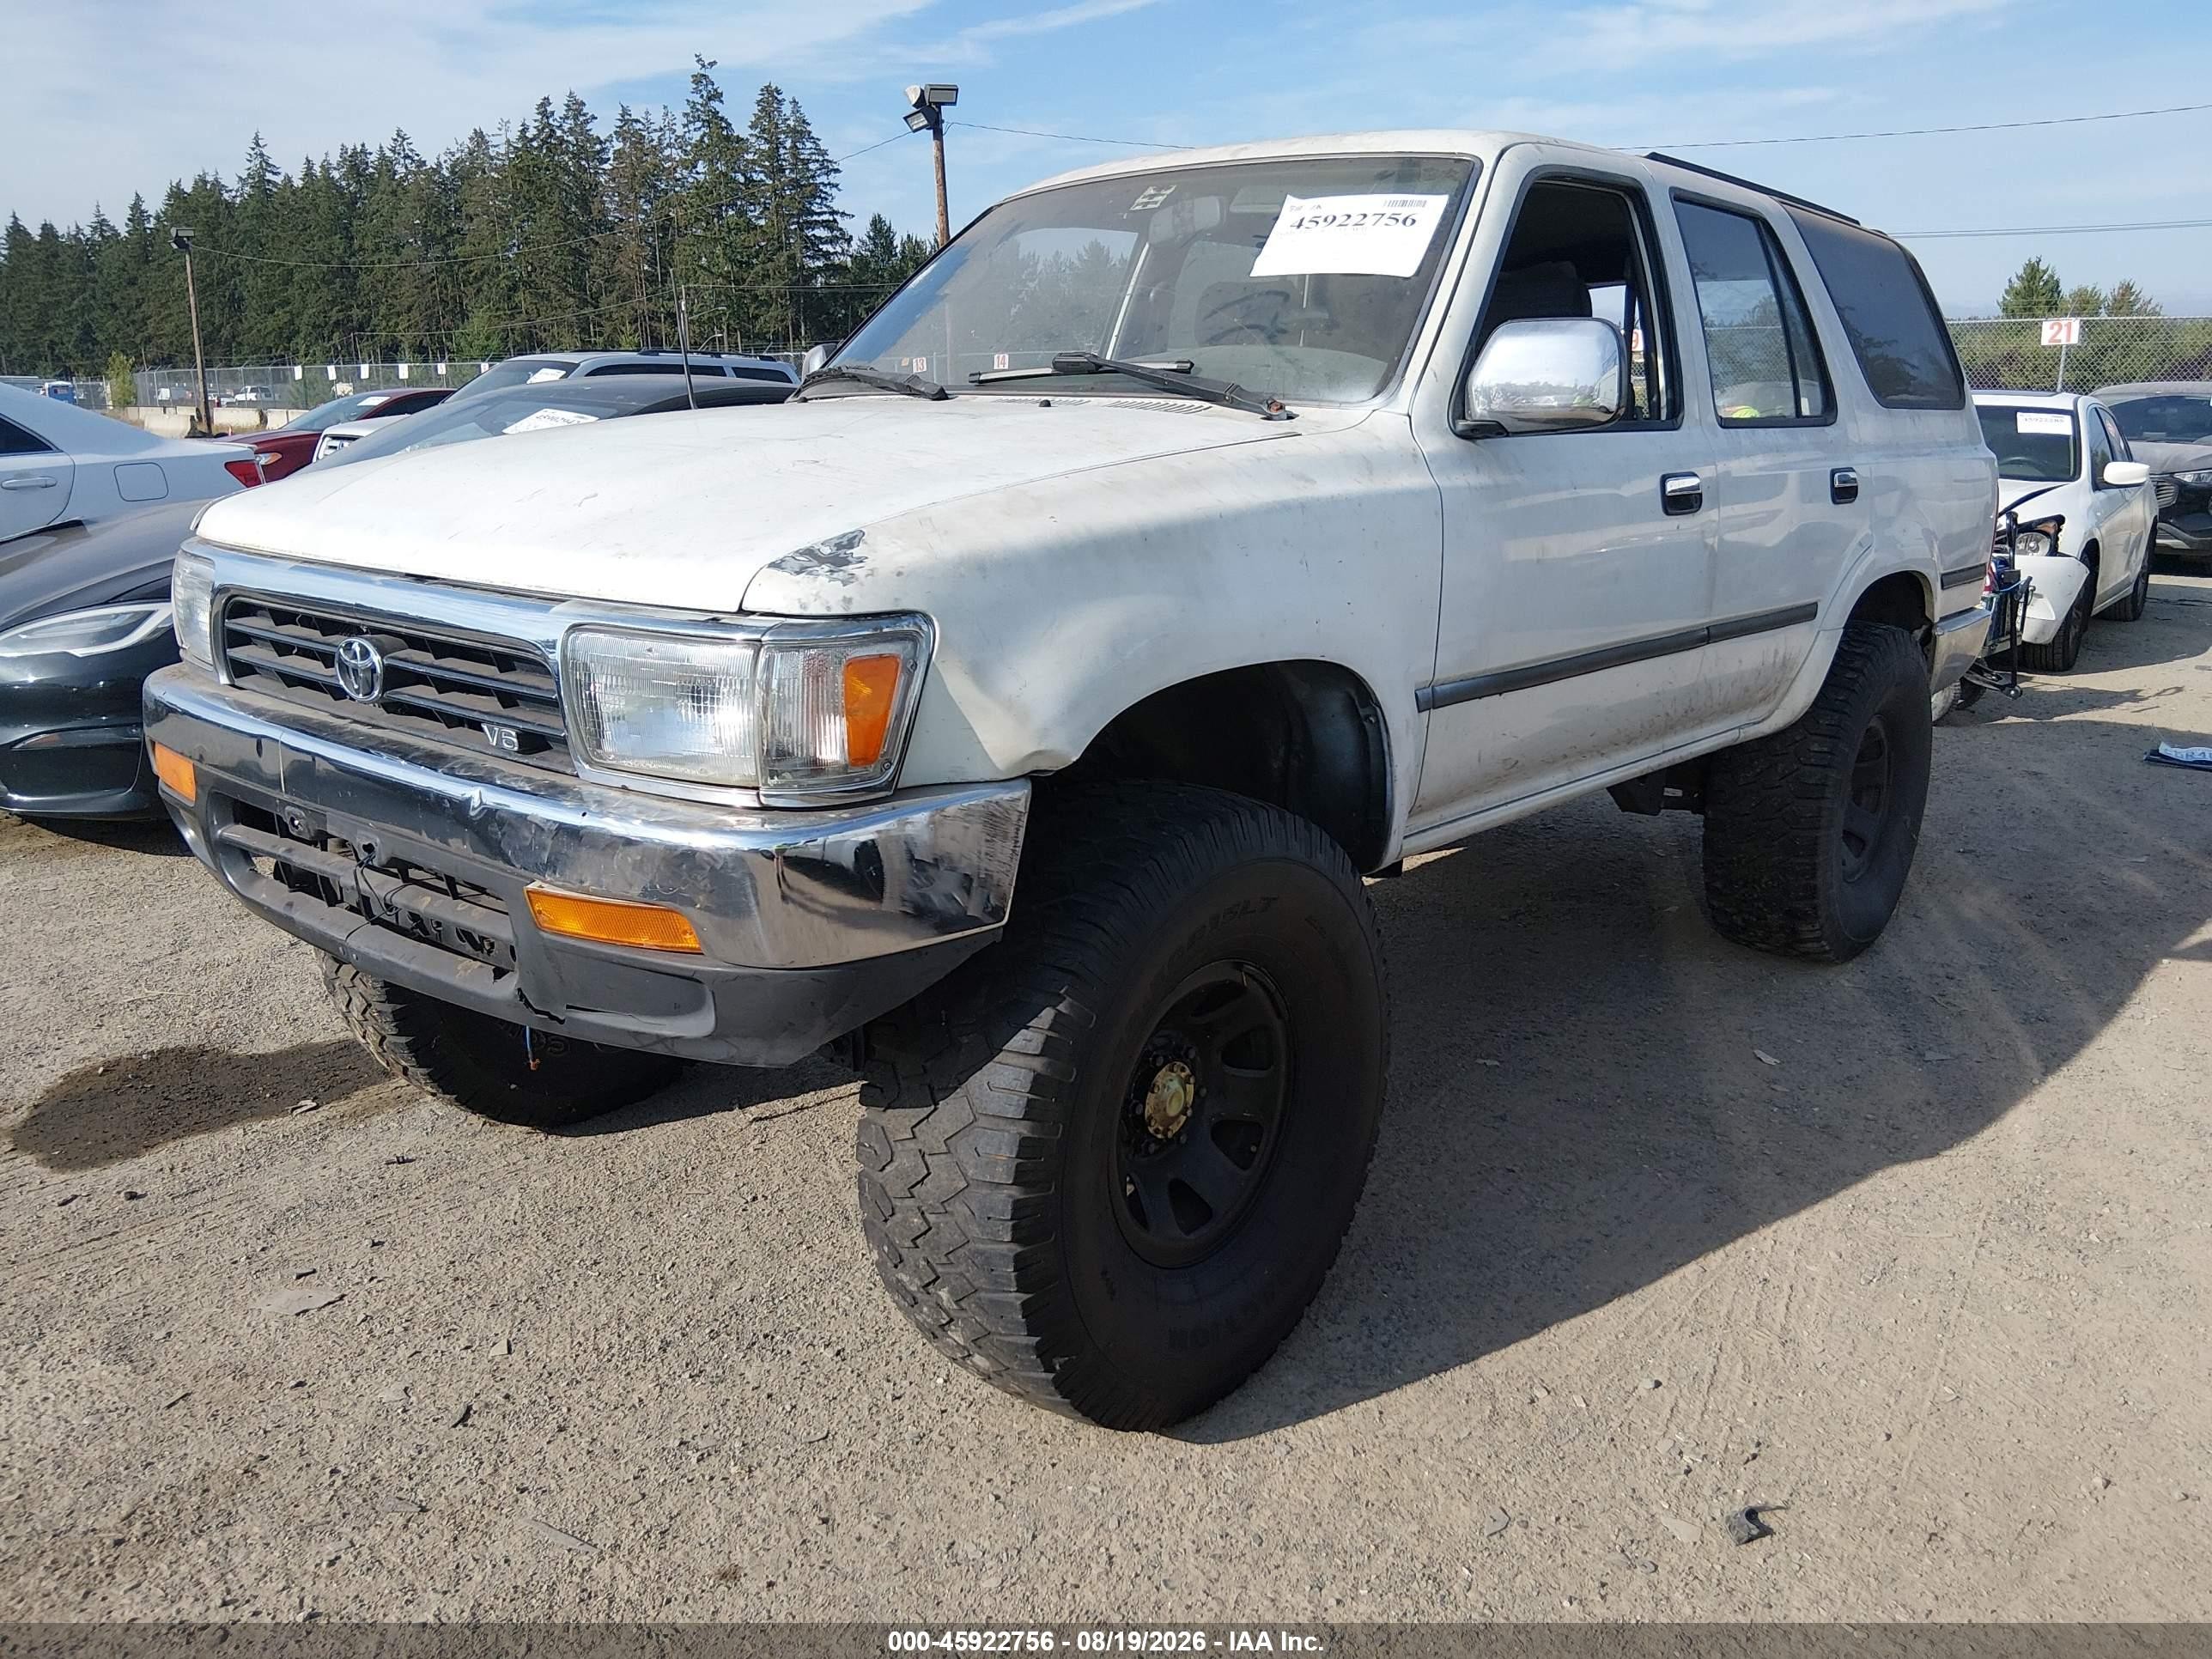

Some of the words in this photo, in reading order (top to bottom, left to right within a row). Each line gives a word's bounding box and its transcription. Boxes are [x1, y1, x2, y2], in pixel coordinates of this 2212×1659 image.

[1290, 213, 1418, 230] 45922756
[2048, 322, 2073, 343] 21
[915, 358, 925, 371] 13
[997, 355, 1006, 368] 14
[482, 725, 519, 750] V6
